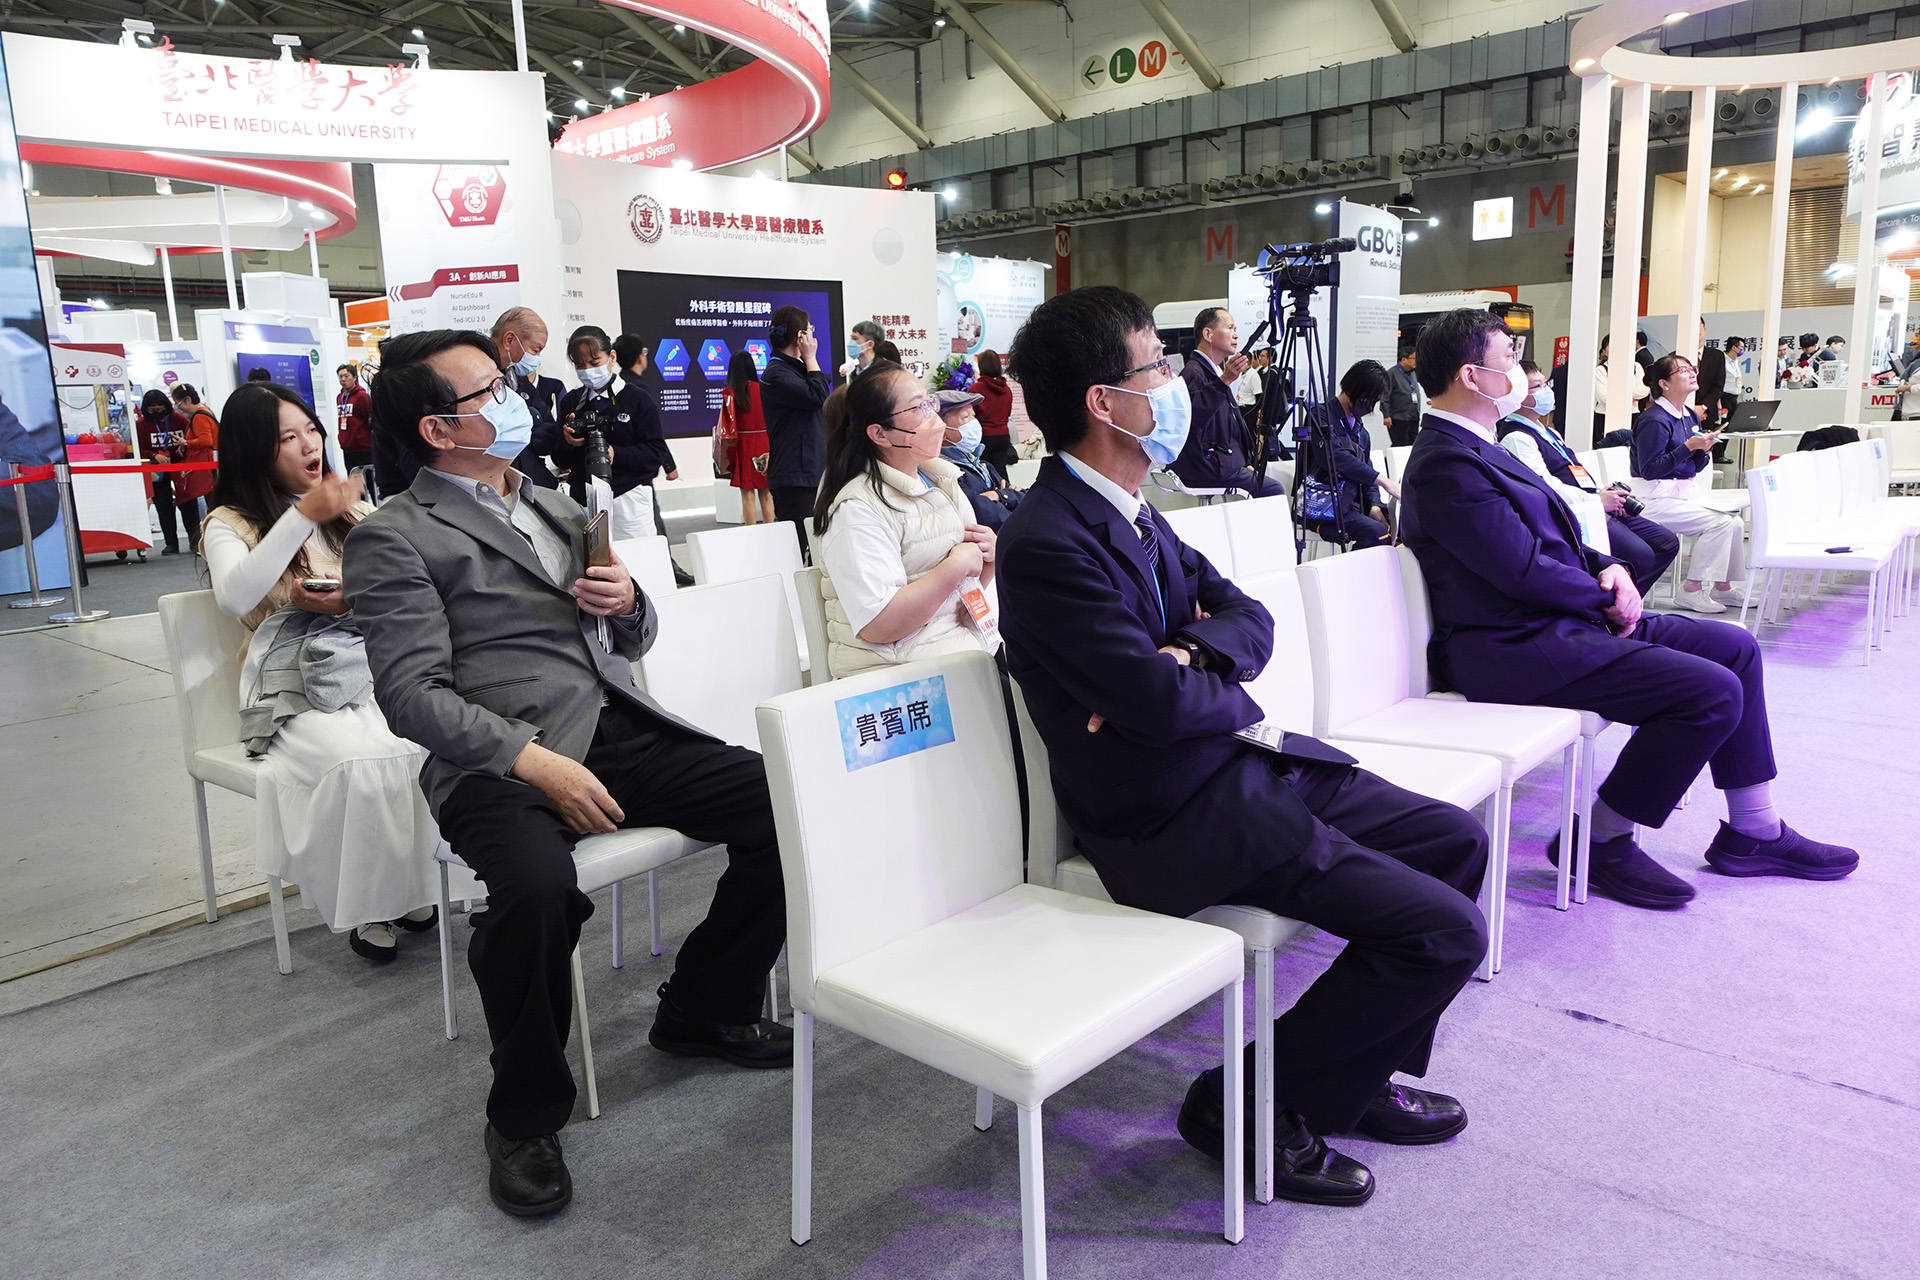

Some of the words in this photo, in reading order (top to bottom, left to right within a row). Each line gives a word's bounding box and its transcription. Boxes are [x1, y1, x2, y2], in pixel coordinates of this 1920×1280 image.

[1116, 54, 1129, 78] L
[1143, 46, 1161, 73] M
[162, 111, 228, 131] TAIPEI
[234, 117, 313, 136] MEDICAL
[318, 123, 417, 141] UNIVERSITY
[646, 142, 676, 161] System
[1528, 184, 1566, 229] M
[669, 207, 825, 235] 臺北醫學大學暨醫療體系
[669, 226, 690, 237] Taipei
[692, 227, 721, 239] Medical
[722, 231, 758, 243] University
[760, 233, 798, 244] Healthcare
[800, 235, 827, 246] System
[1058, 234, 1069, 253] M
[1207, 224, 1233, 262] M
[1357, 225, 1395, 255] GBC
[450, 291, 479, 300] NurseEdu
[459, 303, 490, 311] Dashboard
[689, 299, 772, 314] 外科手術發展里程碑
[898, 329, 927, 340] 大未來
[899, 348, 918, 356] ates
[856, 700, 932, 747] 貴賓席
